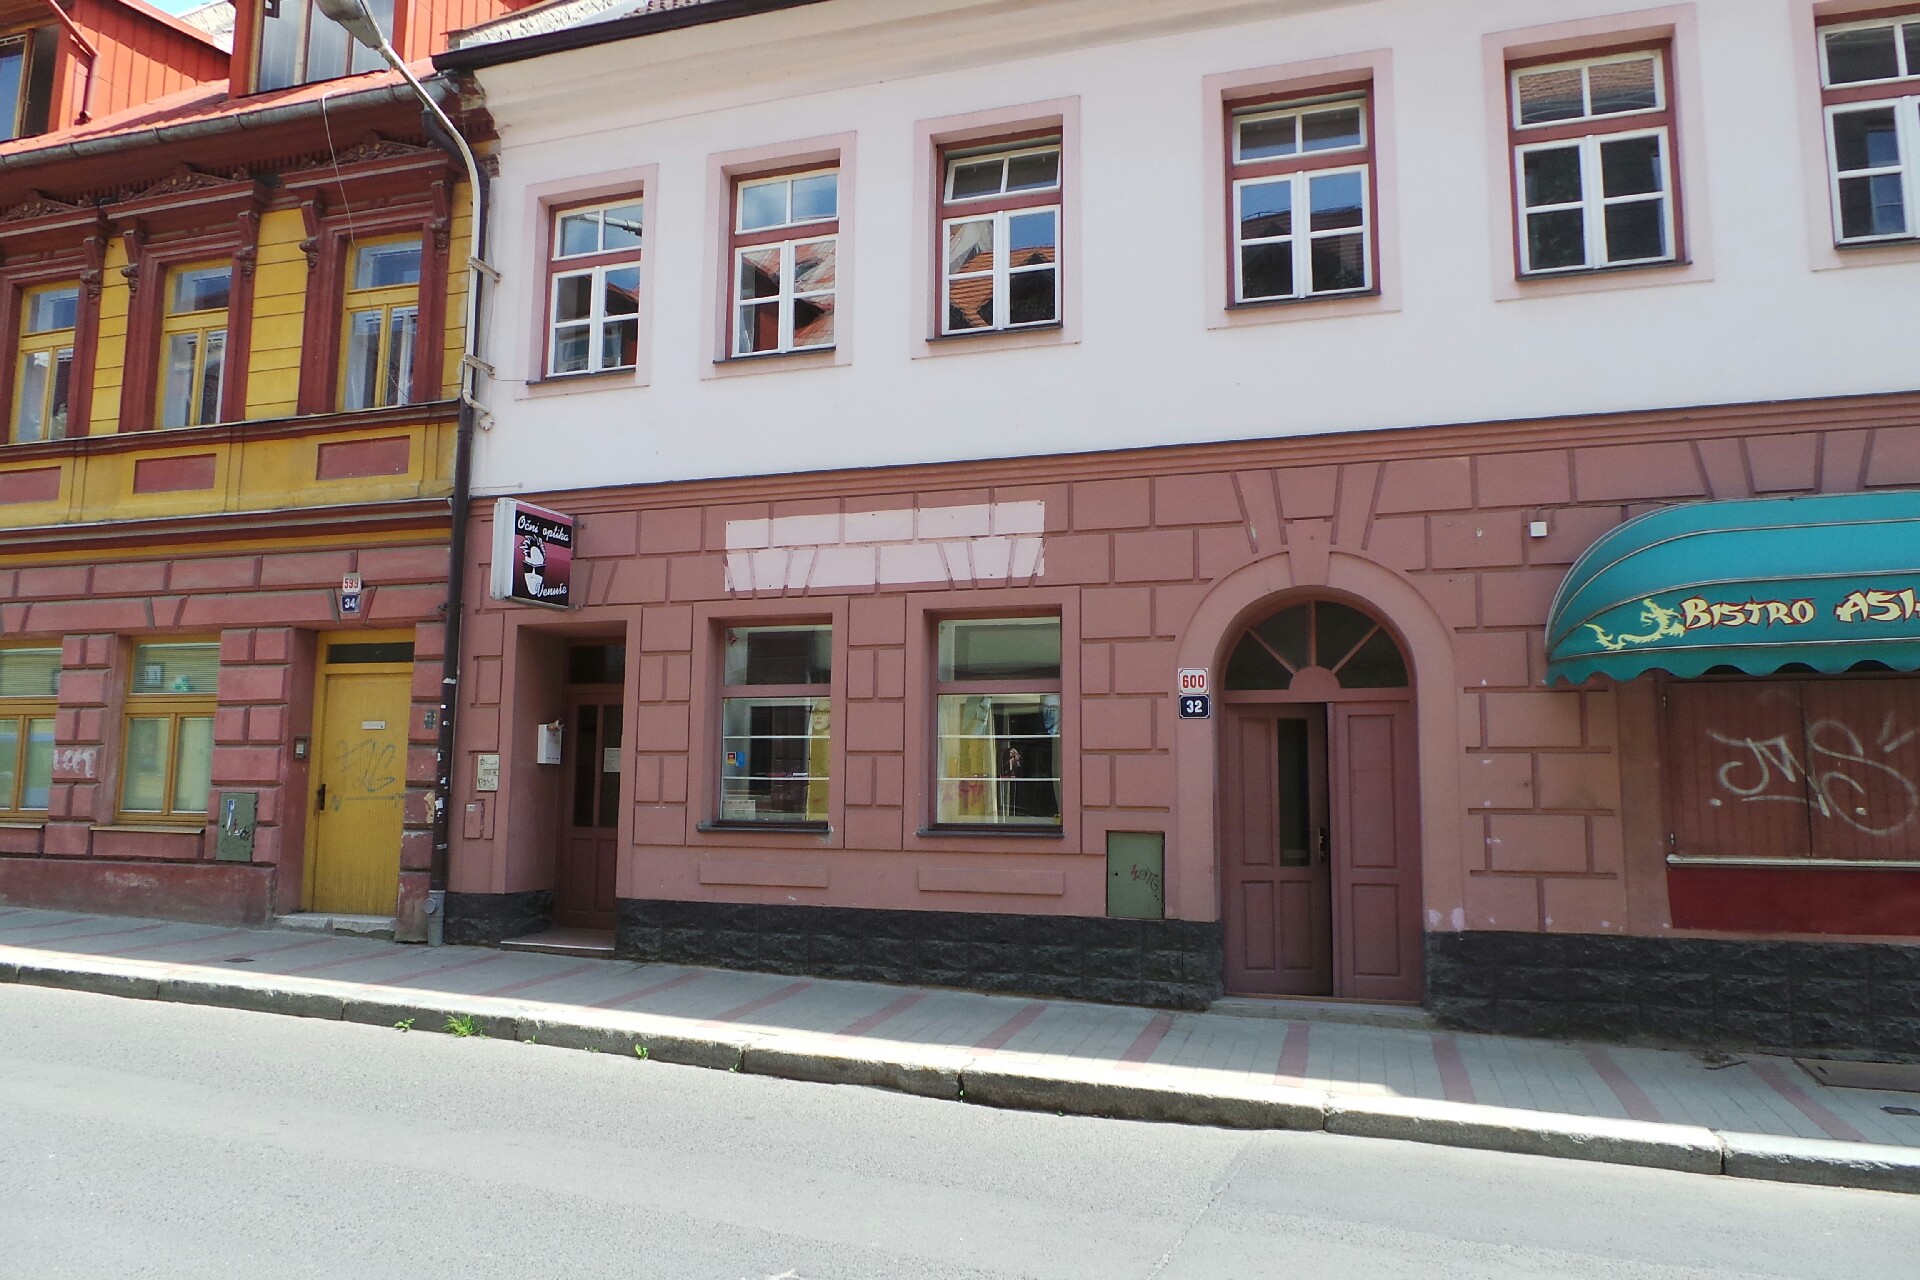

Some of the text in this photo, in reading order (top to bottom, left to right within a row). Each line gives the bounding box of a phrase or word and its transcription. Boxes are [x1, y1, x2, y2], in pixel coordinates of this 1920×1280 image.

[517, 515, 570, 542] Oční optika
[344, 578, 359, 589] 599
[534, 582, 568, 598] Venuše
[344, 597, 357, 609] 34
[1833, 587, 1920, 623] ASI
[1182, 674, 1205, 689] 600
[1186, 699, 1203, 713] 32
